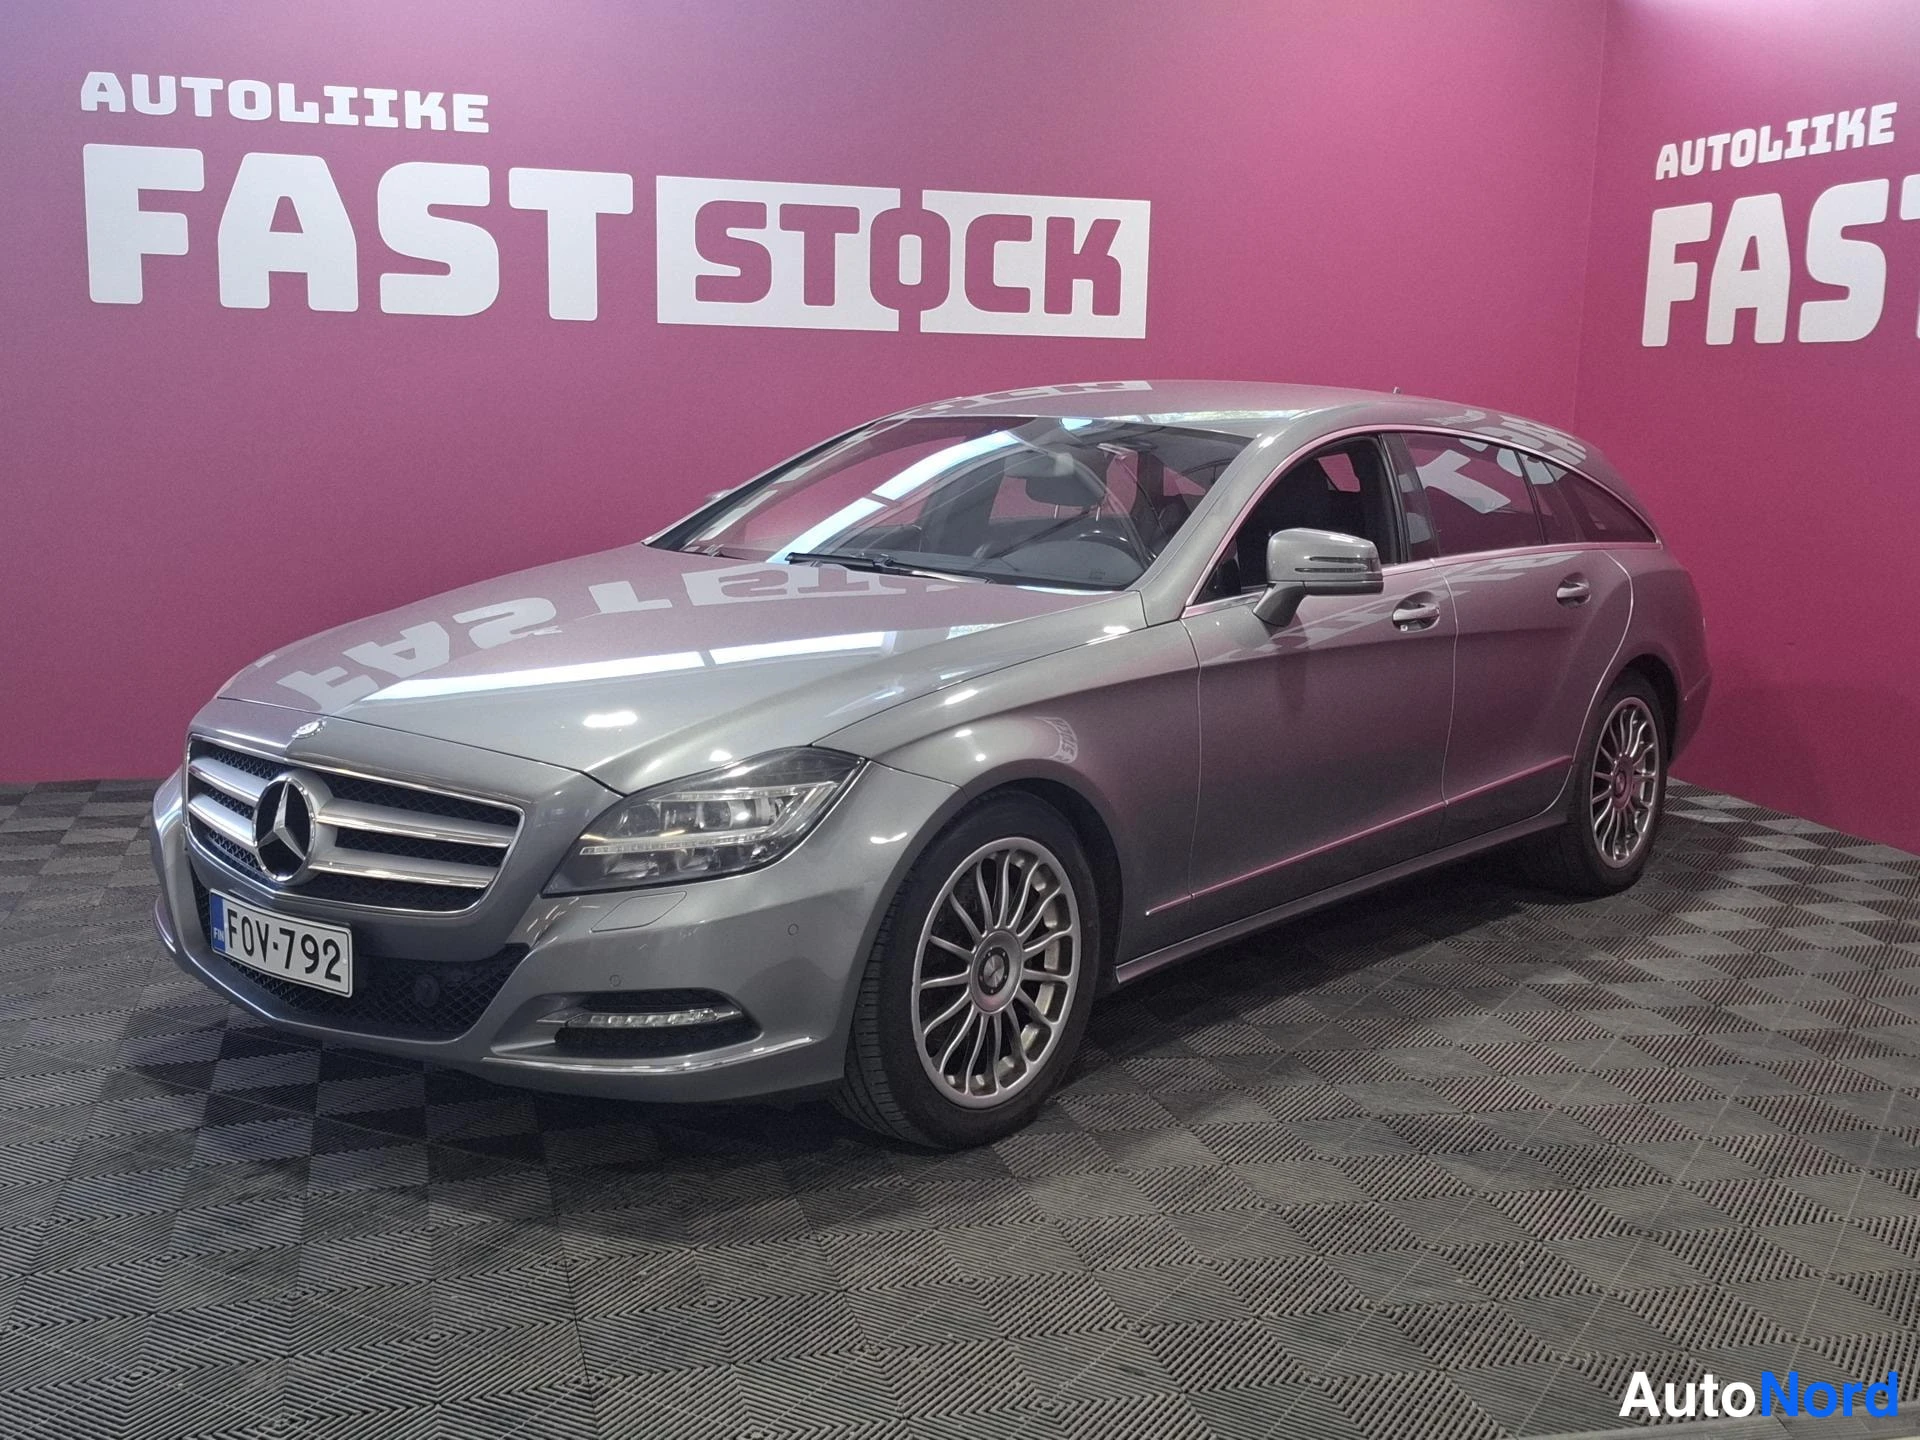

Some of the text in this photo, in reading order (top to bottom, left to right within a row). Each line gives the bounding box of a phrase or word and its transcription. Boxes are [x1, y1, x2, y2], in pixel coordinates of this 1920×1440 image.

[80, 71, 489, 133] AUTOLIIKE
[1655, 102, 1897, 180] AUTOLIIKE
[83, 143, 1125, 321] FAST STOCK
[1642, 174, 1920, 347] FAS
[213, 927, 225, 943] FIN
[227, 908, 342, 983] FOV-792
